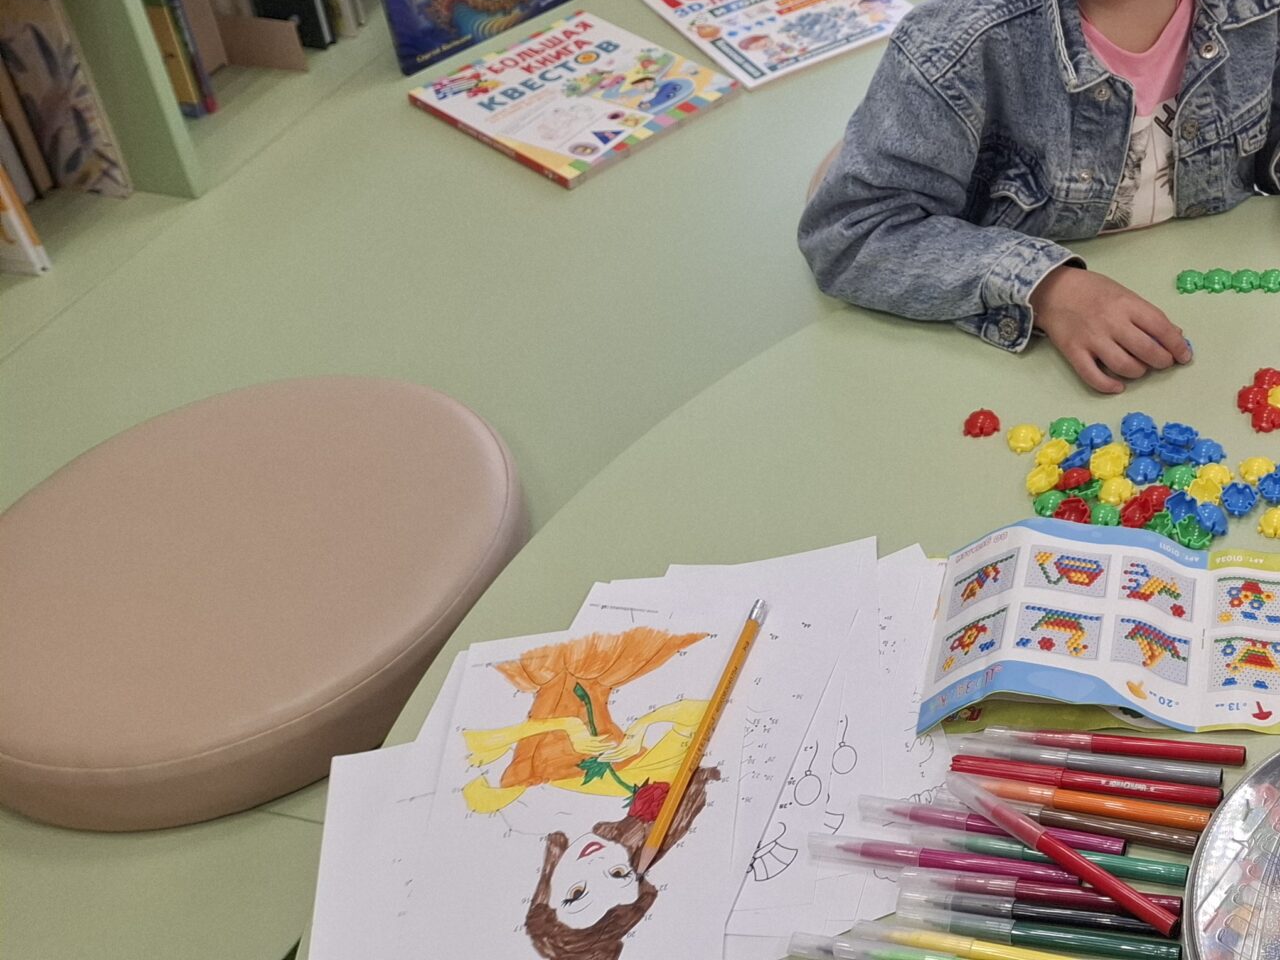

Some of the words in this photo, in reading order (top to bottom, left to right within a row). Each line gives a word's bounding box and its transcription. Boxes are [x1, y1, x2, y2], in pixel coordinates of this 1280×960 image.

[486, 20, 593, 75] БОЛЬШАЯ
[521, 40, 593, 75] КНИГА
[477, 39, 621, 112] КВЕСТОВ
[1158, 696, 1173, 708] 20
[1228, 702, 1241, 711] 13
